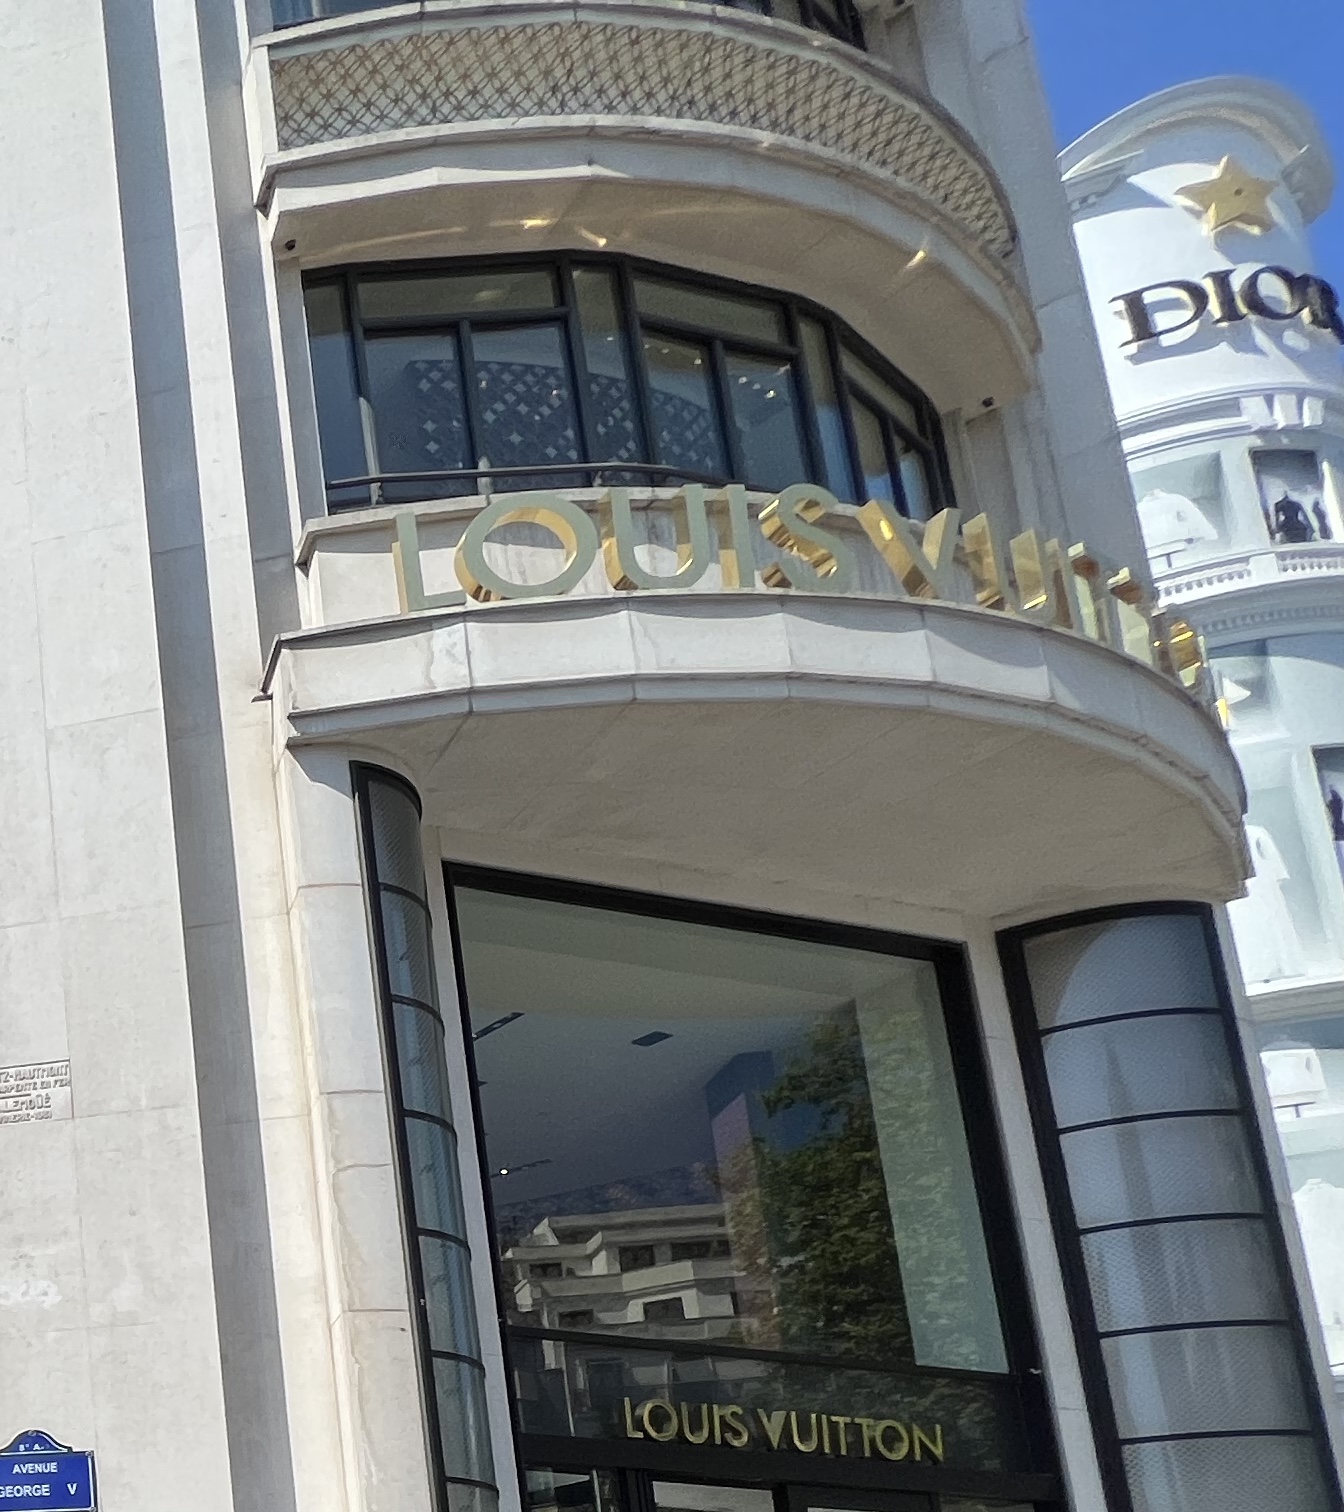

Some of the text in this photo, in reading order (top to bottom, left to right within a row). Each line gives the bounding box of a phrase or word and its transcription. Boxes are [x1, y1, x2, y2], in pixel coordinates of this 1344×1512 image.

[392, 483, 856, 614] LOUIS
[623, 1396, 944, 1463] LOUIS VUITTON
[12, 1462, 58, 1475] AVENUE
[66, 1483, 78, 1495] V
